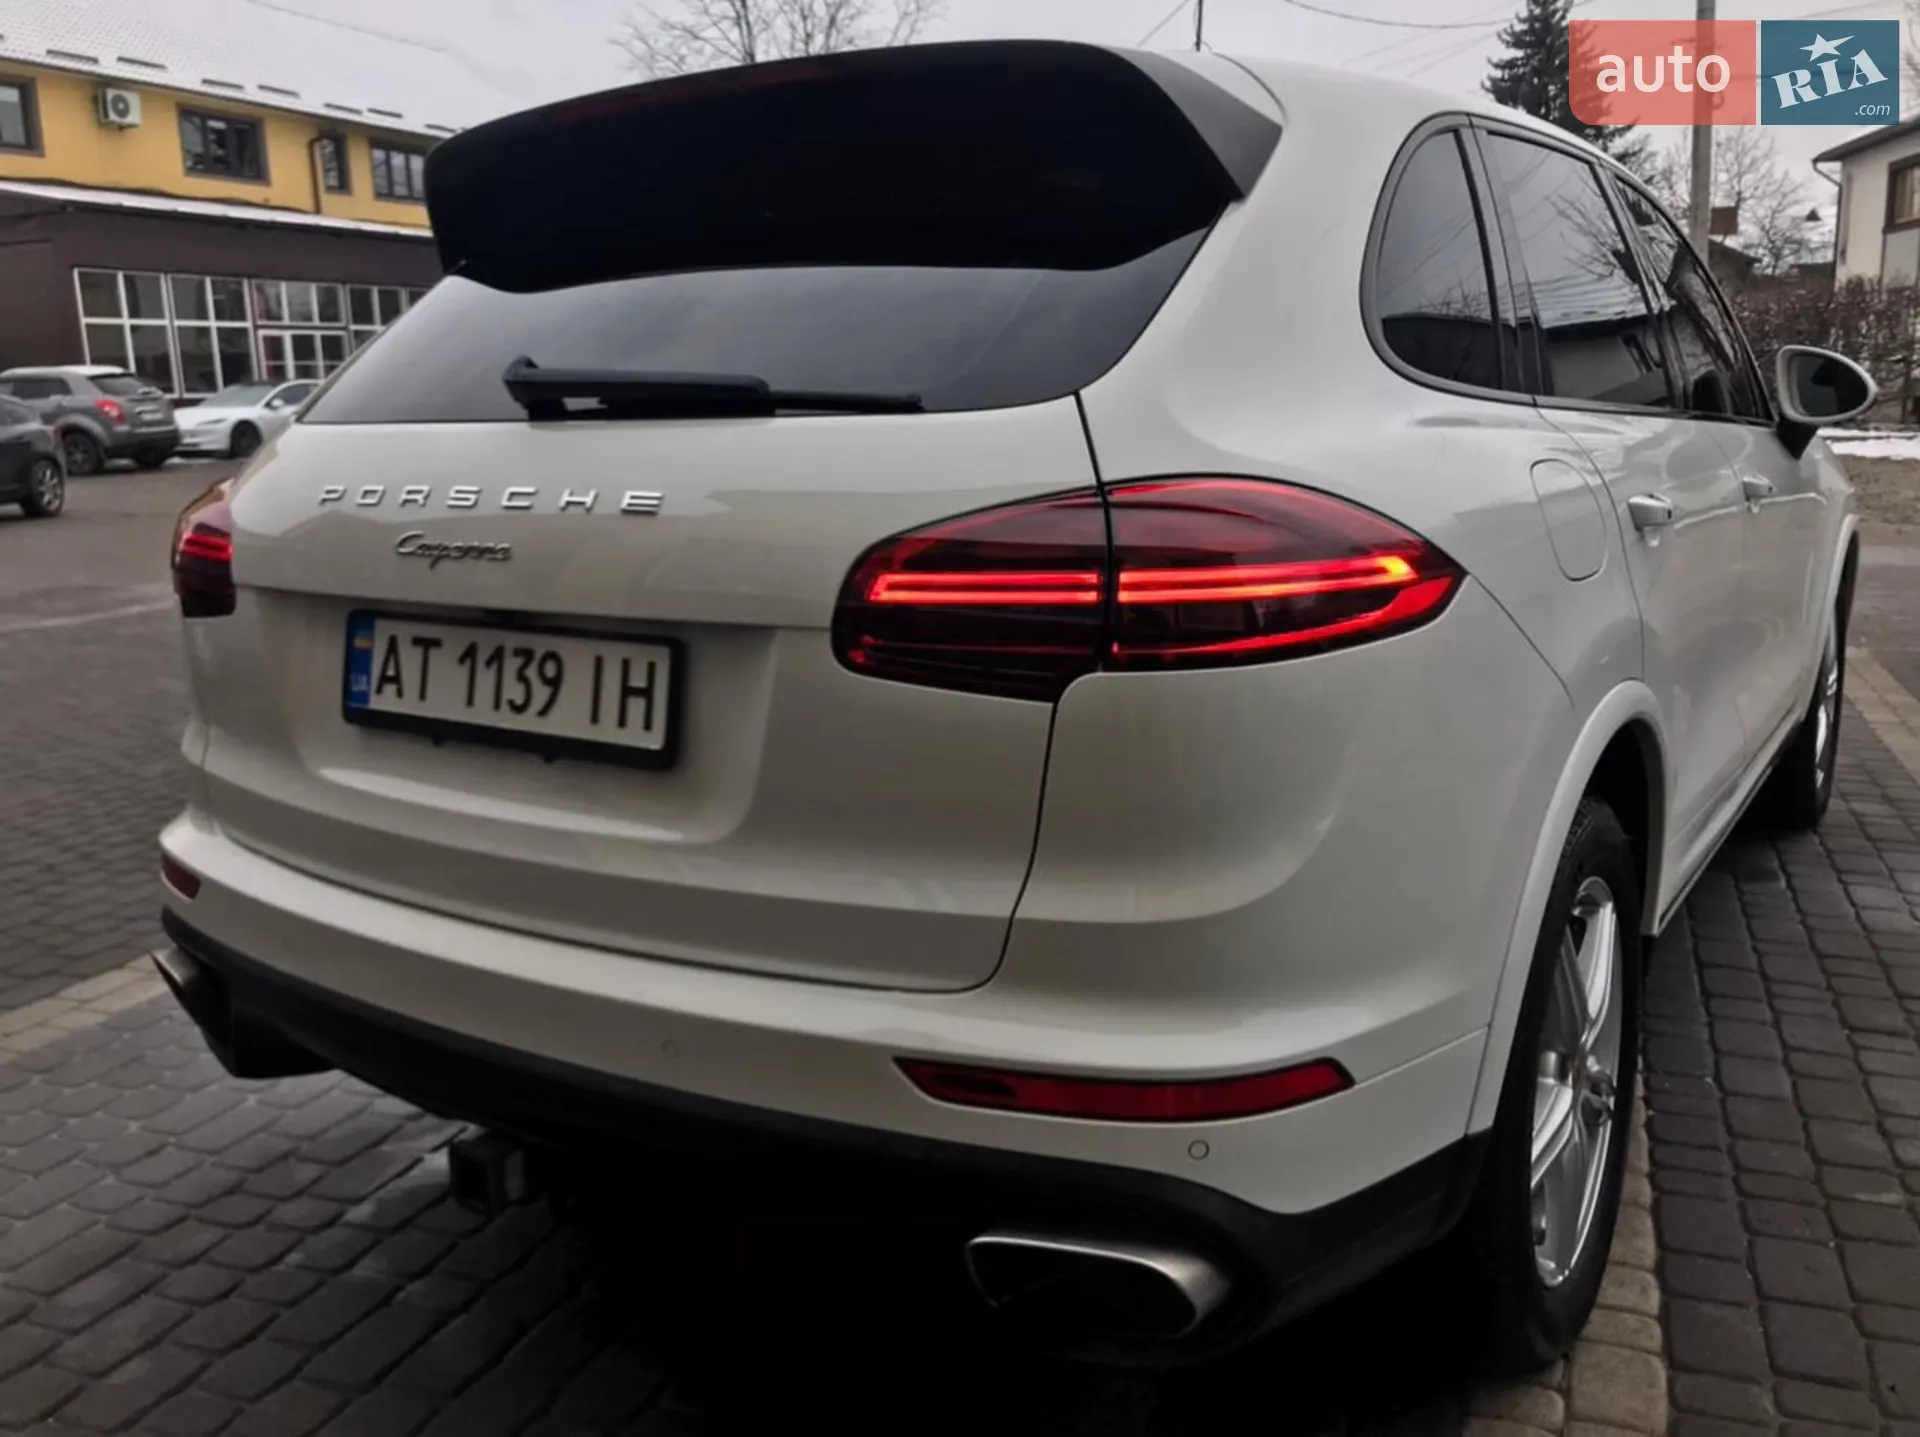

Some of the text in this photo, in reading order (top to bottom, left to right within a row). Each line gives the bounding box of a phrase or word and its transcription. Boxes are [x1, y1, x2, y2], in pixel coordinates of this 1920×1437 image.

[318, 485, 664, 514] PORSCHE
[395, 530, 512, 569] Cayenne
[375, 634, 657, 733] AT 1139 IH
